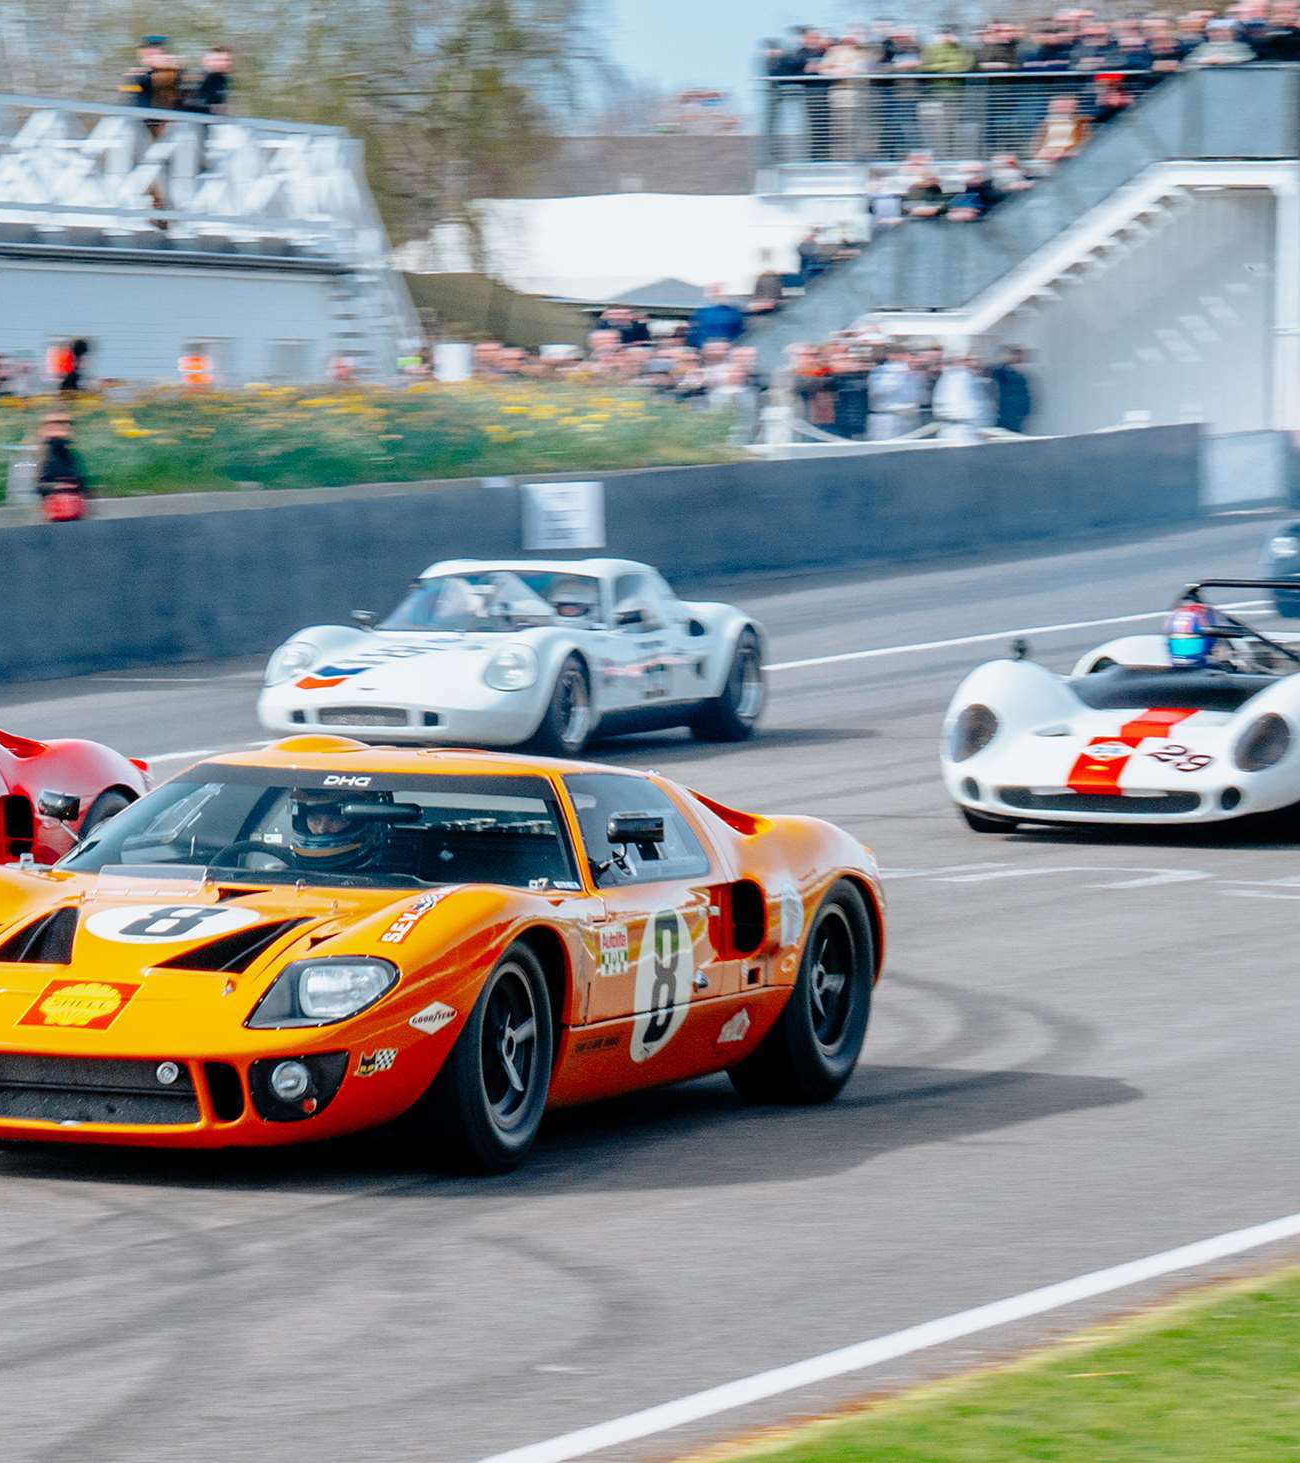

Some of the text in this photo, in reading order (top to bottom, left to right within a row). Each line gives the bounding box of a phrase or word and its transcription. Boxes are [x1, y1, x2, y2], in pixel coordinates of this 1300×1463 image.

[1146, 744, 1214, 772] 29
[323, 775, 372, 787] DHG
[118, 906, 229, 937] 8
[642, 908, 680, 1044] 8
